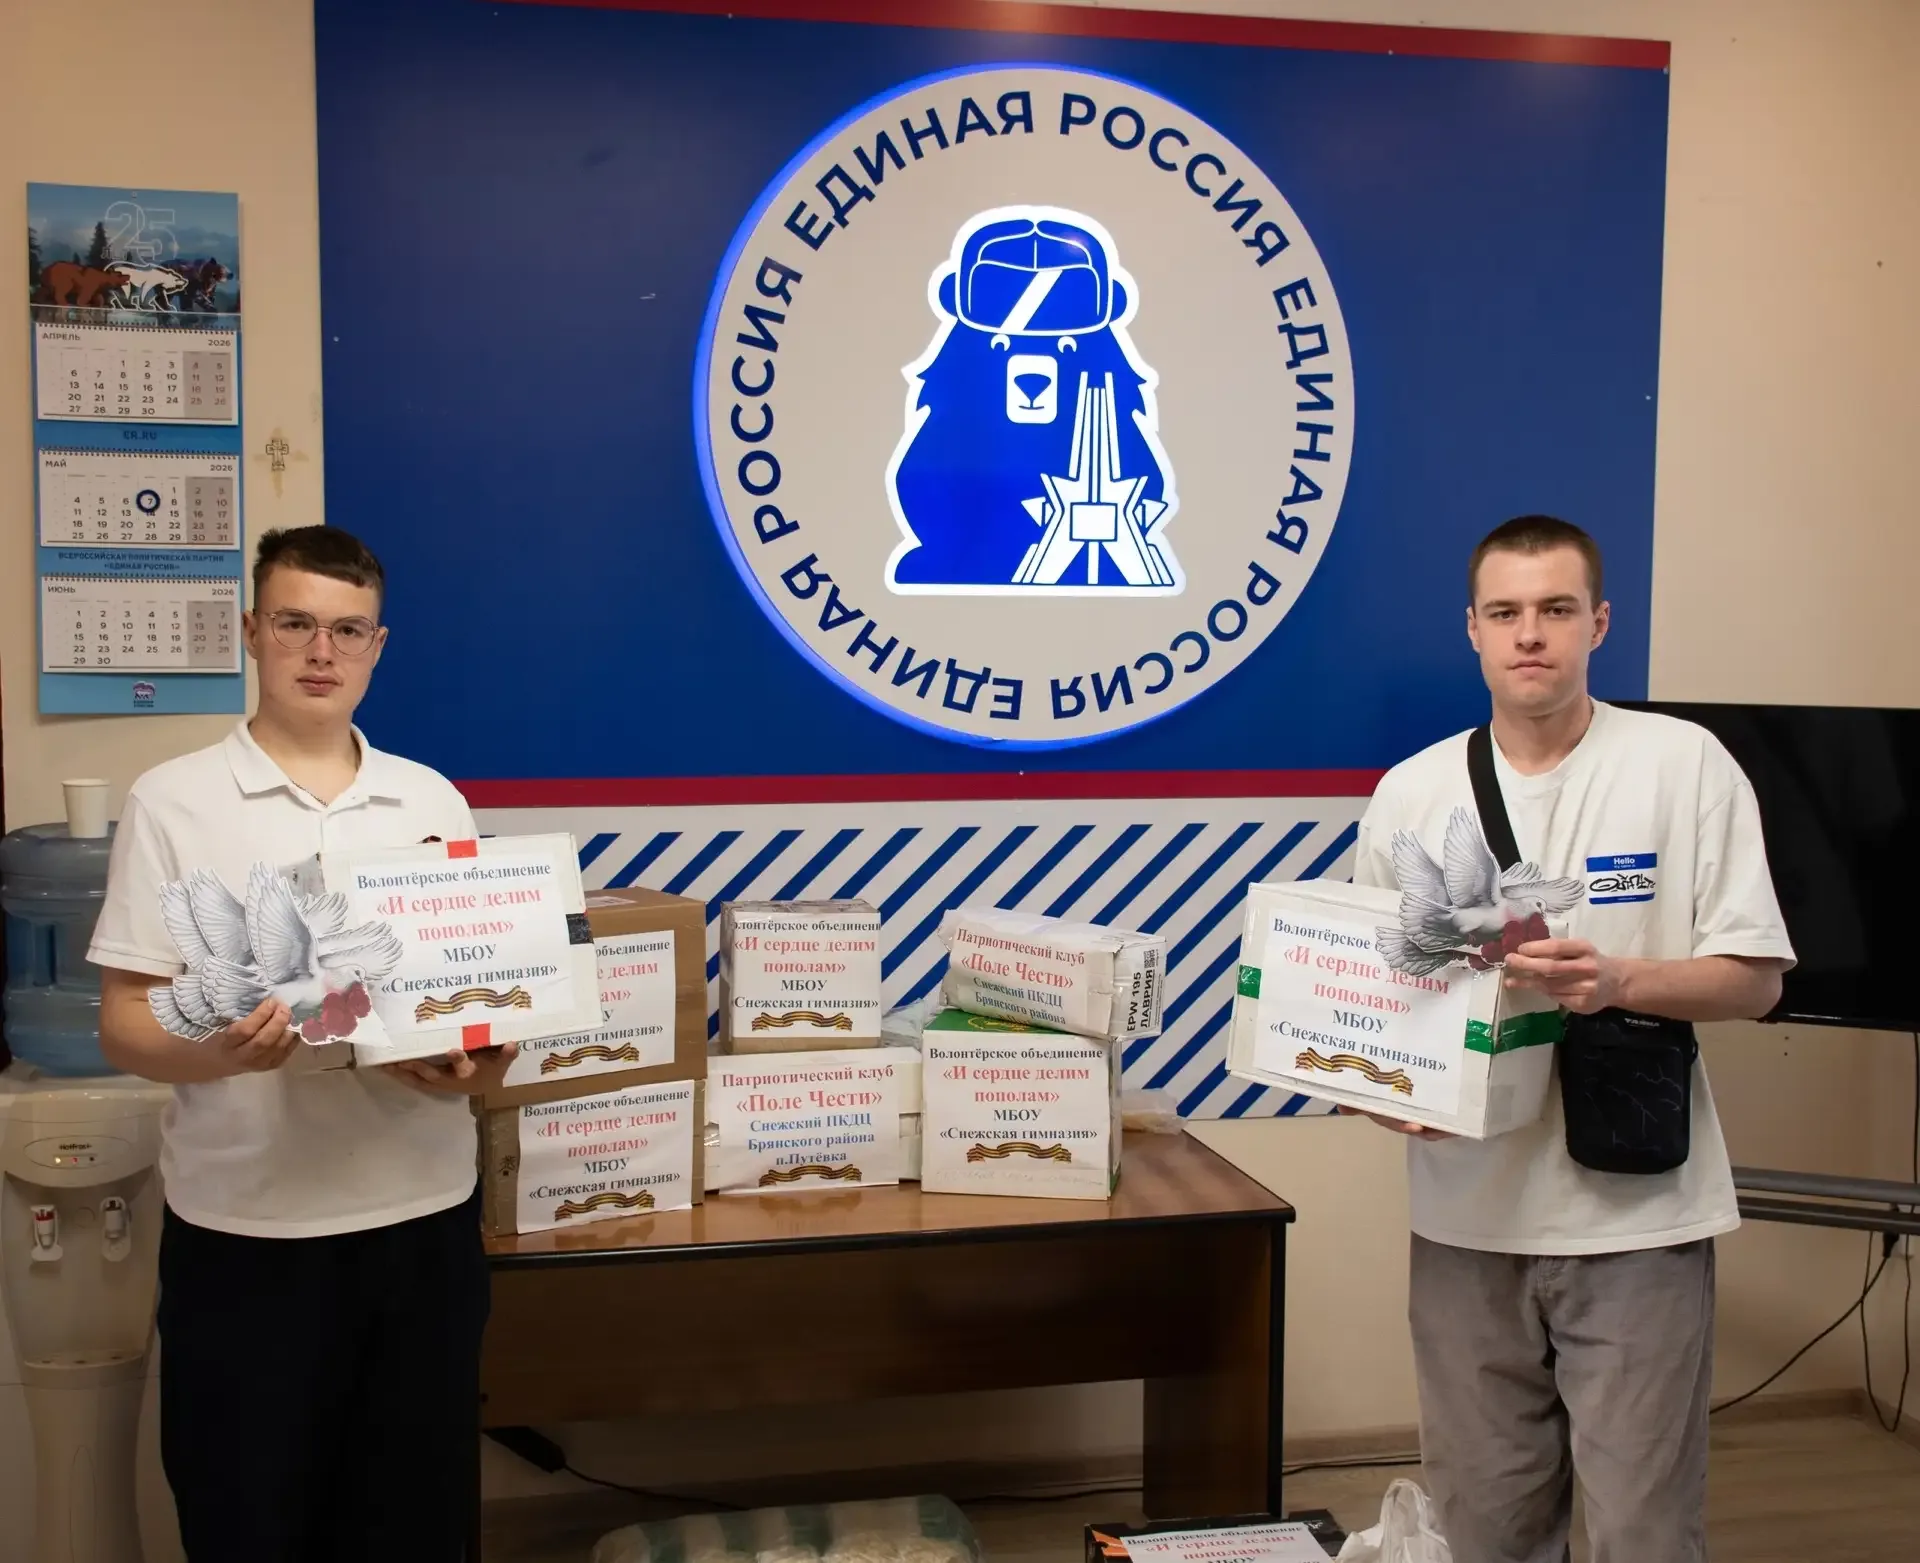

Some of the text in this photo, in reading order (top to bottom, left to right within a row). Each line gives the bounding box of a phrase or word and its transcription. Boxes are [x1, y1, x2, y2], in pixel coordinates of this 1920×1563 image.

[784, 91, 1290, 267] ЕДИНАЯ РОССИЯ
[42, 332, 81, 341] АПРЕЛЬ
[208, 339, 231, 347] 2026
[166, 372, 178, 381] 10
[69, 381, 177, 392] 13 14 15 16 17
[67, 393, 179, 404] 20 21 22 23 24
[68, 404, 156, 416] 27 28 29 30
[45, 459, 67, 468] МАЙ
[730, 256, 1023, 720] ЕДИНАЯ РОССИЯ
[1050, 277, 1334, 720] ЕДИНАЯ РОССИЯ
[73, 508, 180, 518] 11 12 13 15
[72, 520, 181, 530] 18 19 20 21 22
[71, 531, 181, 541] 25 26 27 28 29
[47, 586, 76, 594] ИЮНЬ
[211, 588, 234, 596] 2026
[122, 622, 134, 630] 10
[148, 622, 156, 630] 11
[171, 622, 181, 631] 12
[74, 633, 182, 642] 15 16 17 18 19
[73, 645, 183, 654] 22 23 24 25 26
[73, 656, 111, 665] 29 30
[1613, 857, 1635, 865] Hello
[357, 864, 551, 889] Волонтёрское объединение
[377, 889, 541, 915] «И сердце делим
[418, 921, 514, 941] пополам»
[1273, 918, 1370, 949] Волонтёрское
[444, 944, 496, 963] МБОУ
[734, 936, 875, 955] «И сердце делим
[957, 928, 1085, 967] Патриотический клуб
[608, 962, 658, 978] делим
[764, 961, 846, 973] пополам»
[961, 953, 1074, 989] «Поле Чести»
[1284, 945, 1310, 965] «И
[1316, 955, 1381, 980] сердце
[381, 964, 557, 993] «Снежская гимназия»
[780, 980, 827, 991] МБОУ
[974, 977, 1063, 1009] Снежский ПКДЦ
[1127, 971, 1141, 1032] EPW 195
[1141, 969, 1153, 1028] ЛАВРИЯ
[1314, 982, 1411, 1014] пополам»
[808, 1000, 879, 1008] гимназия»
[975, 993, 1027, 1015] Брянского
[1030, 1008, 1066, 1025] района
[1332, 1010, 1388, 1034] МБОУ
[595, 1025, 663, 1042] гимназия»
[930, 1048, 1102, 1060] Волонтёрское объединение
[1270, 1021, 1447, 1072] «Снежская гимназия»
[722, 1065, 893, 1088] Патриотический клуб
[943, 1066, 1090, 1083] «И сердце делим
[524, 1090, 689, 1117] Волонтёрское объединение
[736, 1090, 882, 1112] «Поле Чести»
[975, 1091, 1059, 1102] пополам»
[750, 1112, 871, 1132] Снежский ПКДЦ
[993, 1109, 1042, 1121] МБОУ
[537, 1111, 676, 1137] «И сердце делим
[940, 1127, 1097, 1140] «Снежская гимназия»
[568, 1138, 648, 1158] пополам»
[748, 1133, 874, 1152] Брянского района
[583, 1157, 630, 1174] МБОУ
[776, 1152, 847, 1166] п.Путёвка
[528, 1172, 680, 1200] «Снежская гимназия»
